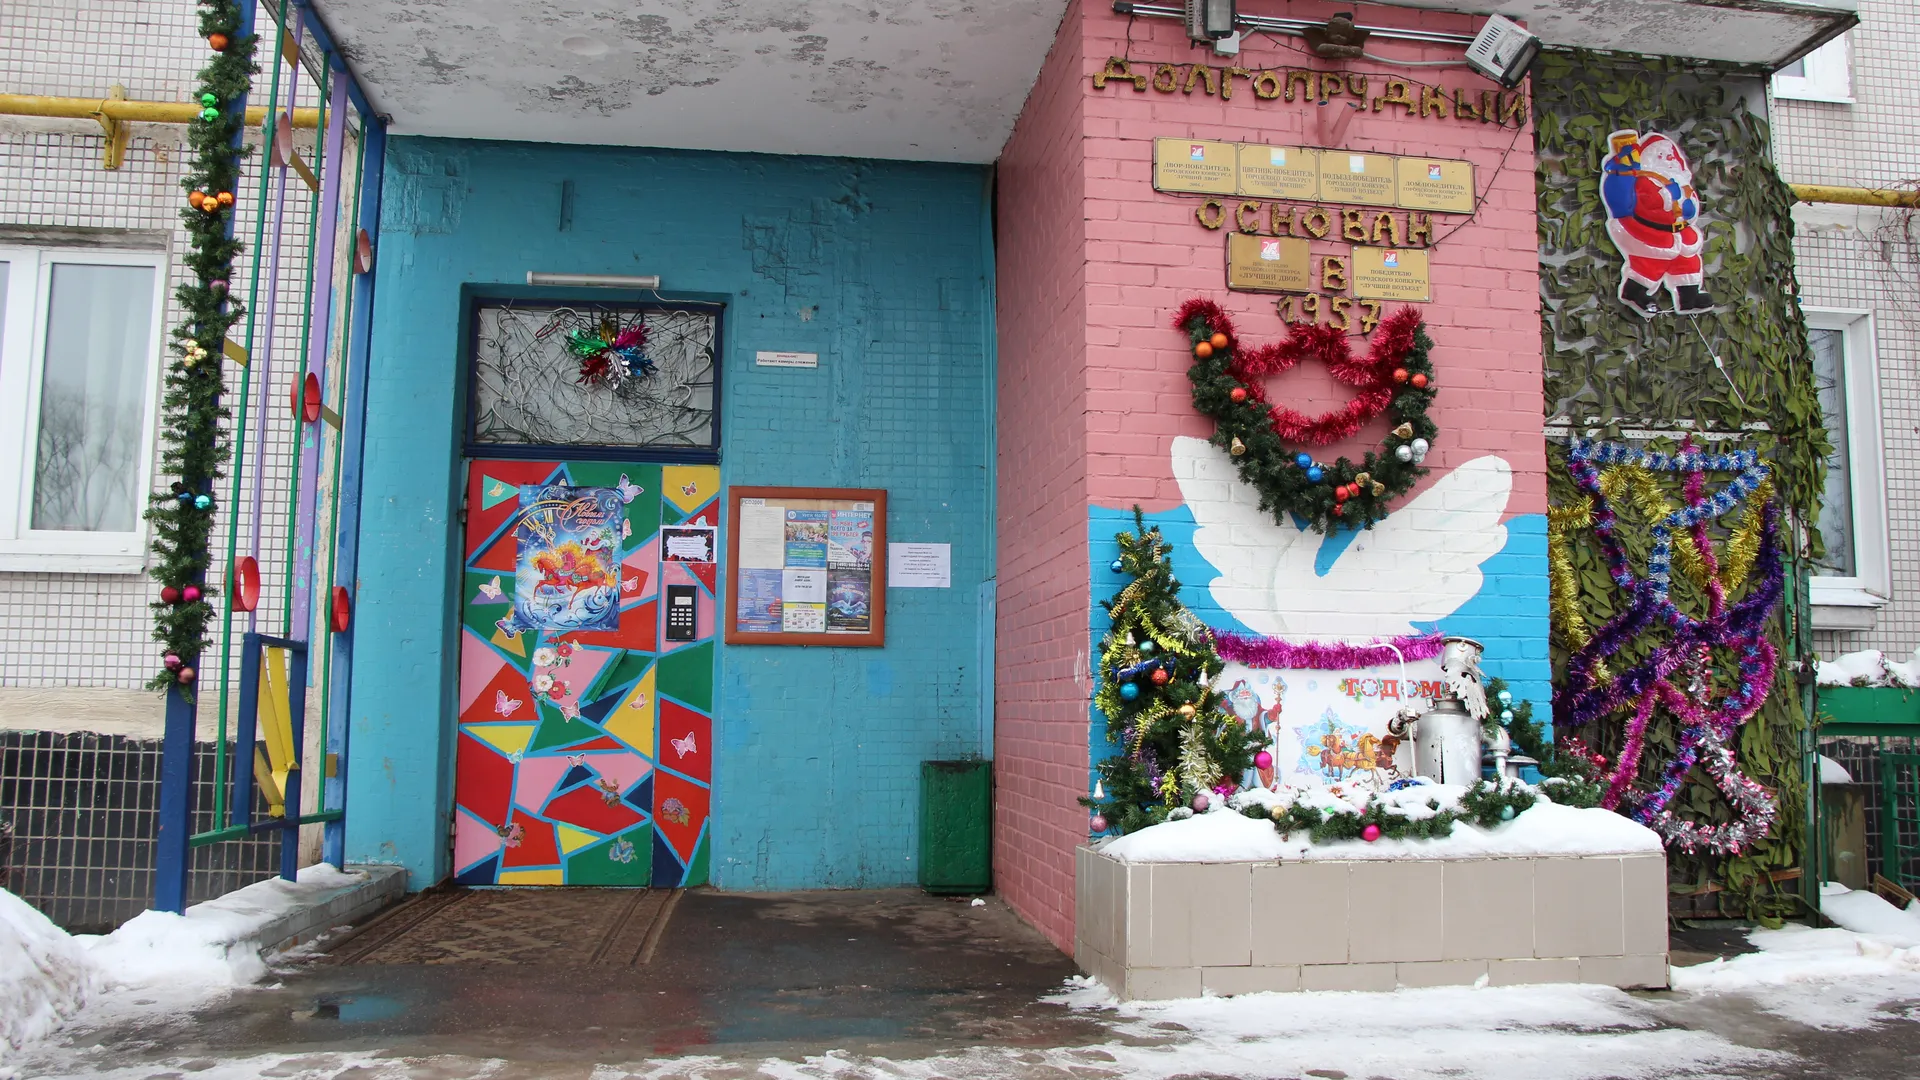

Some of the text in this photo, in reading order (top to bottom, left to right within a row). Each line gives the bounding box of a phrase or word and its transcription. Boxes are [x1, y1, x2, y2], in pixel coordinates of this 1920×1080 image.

[1196, 197, 1433, 247] ОСНОВАН
[1321, 255, 1348, 291] В
[1370, 269, 1412, 277] ПОБЕДИТЕЛЮ
[1278, 293, 1381, 334] 1957
